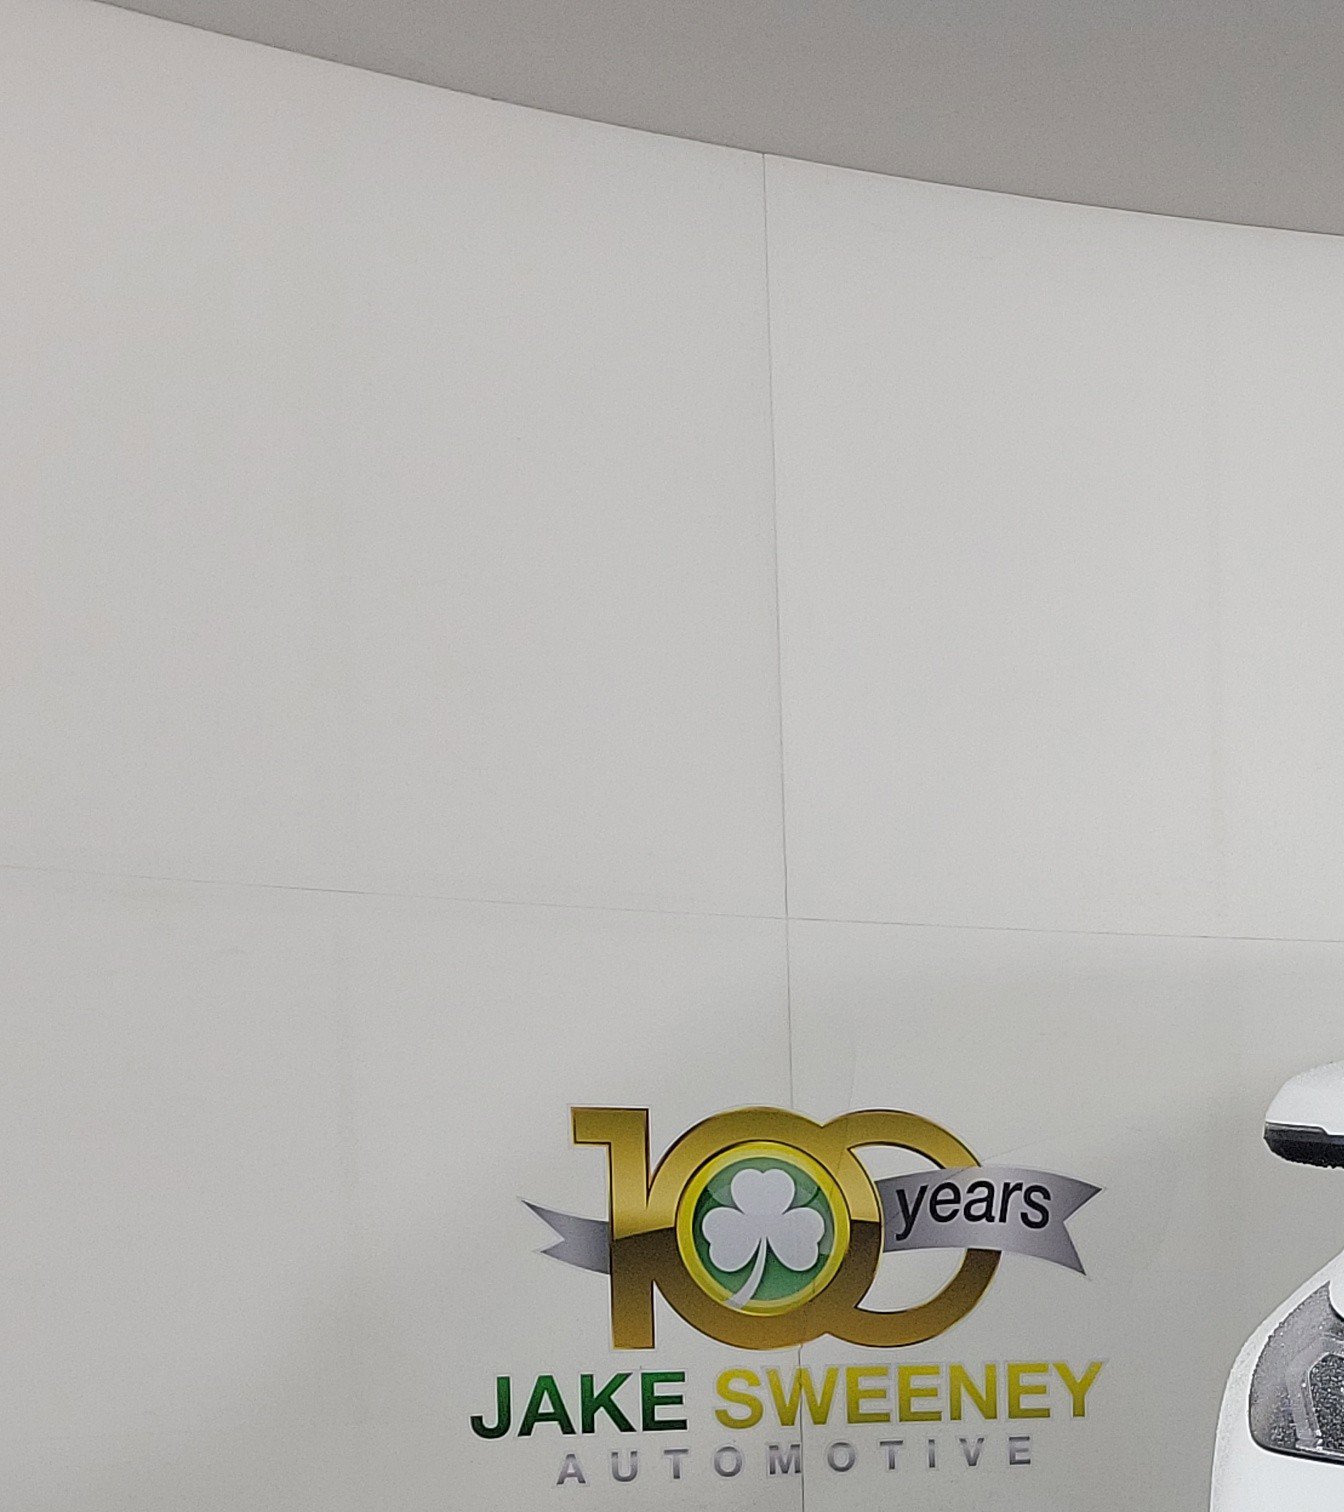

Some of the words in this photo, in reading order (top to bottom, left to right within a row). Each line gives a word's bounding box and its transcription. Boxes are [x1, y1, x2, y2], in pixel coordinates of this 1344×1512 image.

[571, 1106, 1002, 1350] 100
[895, 1180, 1052, 1241] years
[470, 1370, 688, 1440] JAKE
[714, 1361, 1103, 1428] SWEENEY
[556, 1436, 1032, 1486] AUTOMOTIVE
